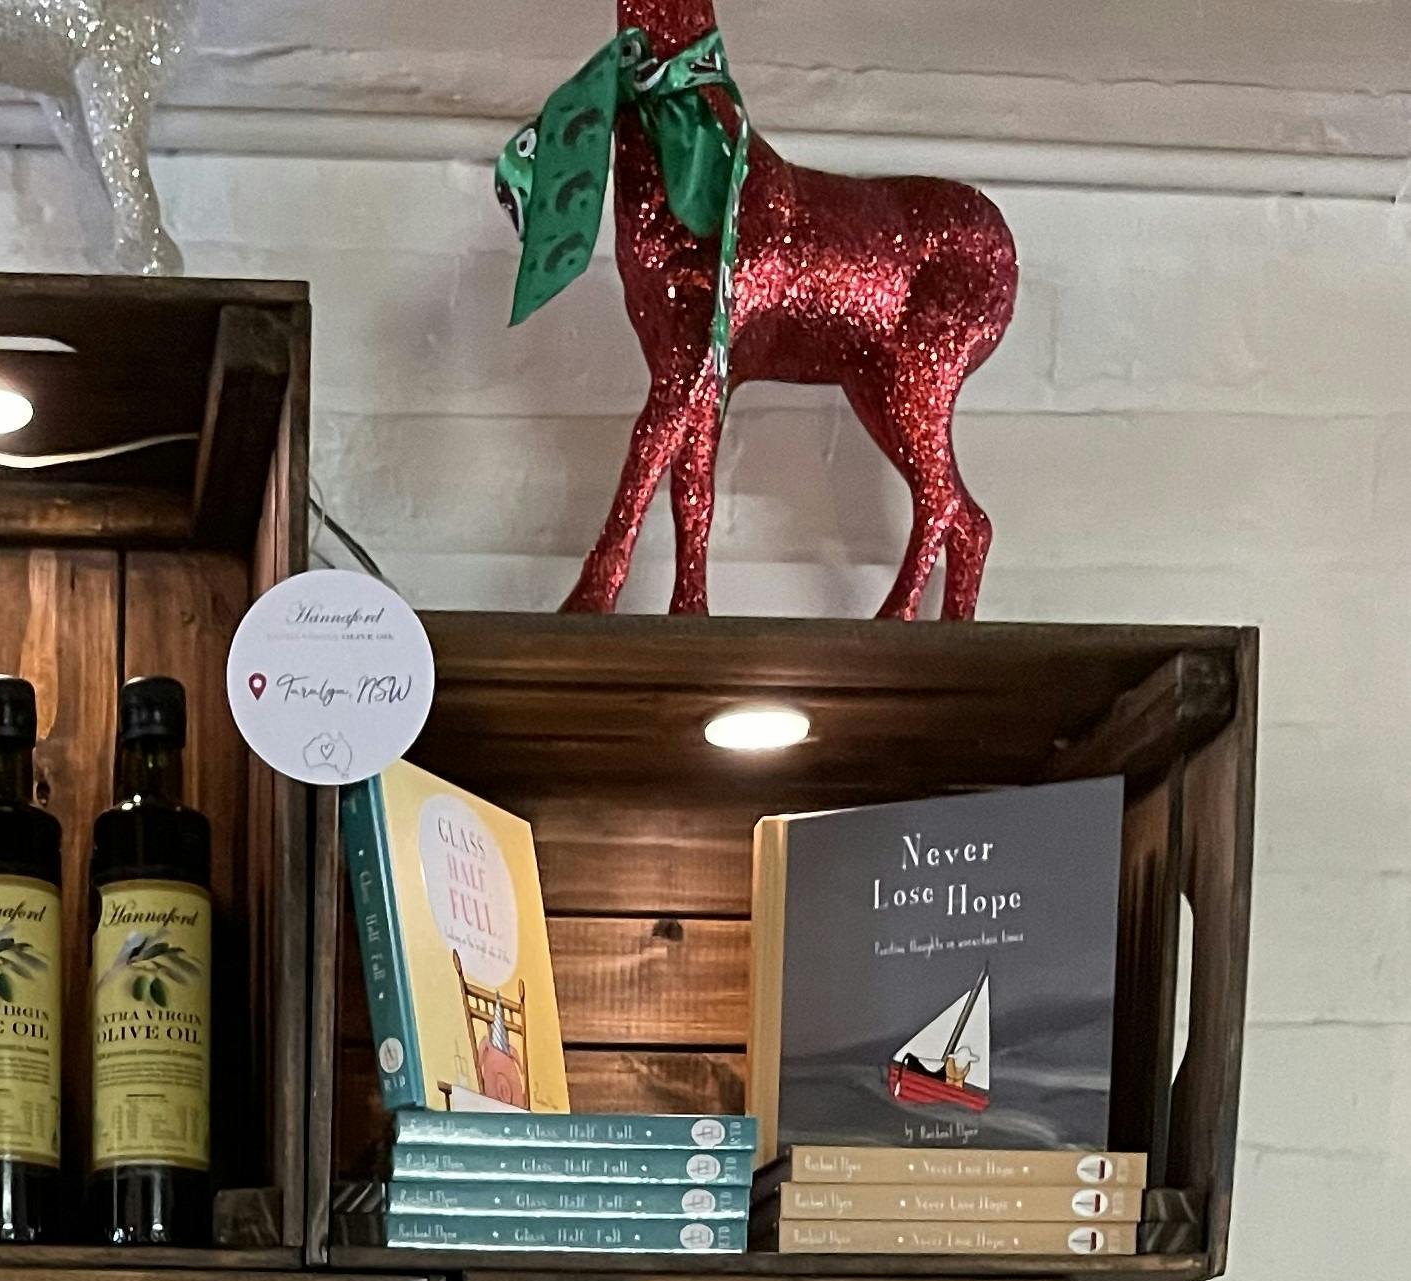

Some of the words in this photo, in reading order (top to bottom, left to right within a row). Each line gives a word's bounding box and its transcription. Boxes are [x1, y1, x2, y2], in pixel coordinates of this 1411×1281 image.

[287, 602, 384, 629] Hannaford
[357, 675, 412, 703] NSW
[438, 816, 486, 860] GLASS
[902, 833, 993, 871] Never
[447, 853, 486, 892] HALF
[449, 890, 496, 936] FULL
[874, 879, 933, 910] Lose
[946, 884, 1021, 919] Hope
[103, 902, 198, 928] Hannaford
[13, 1022, 48, 1040] OIL
[147, 1010, 201, 1025] VIRGIN
[167, 1027, 201, 1044] OIL
